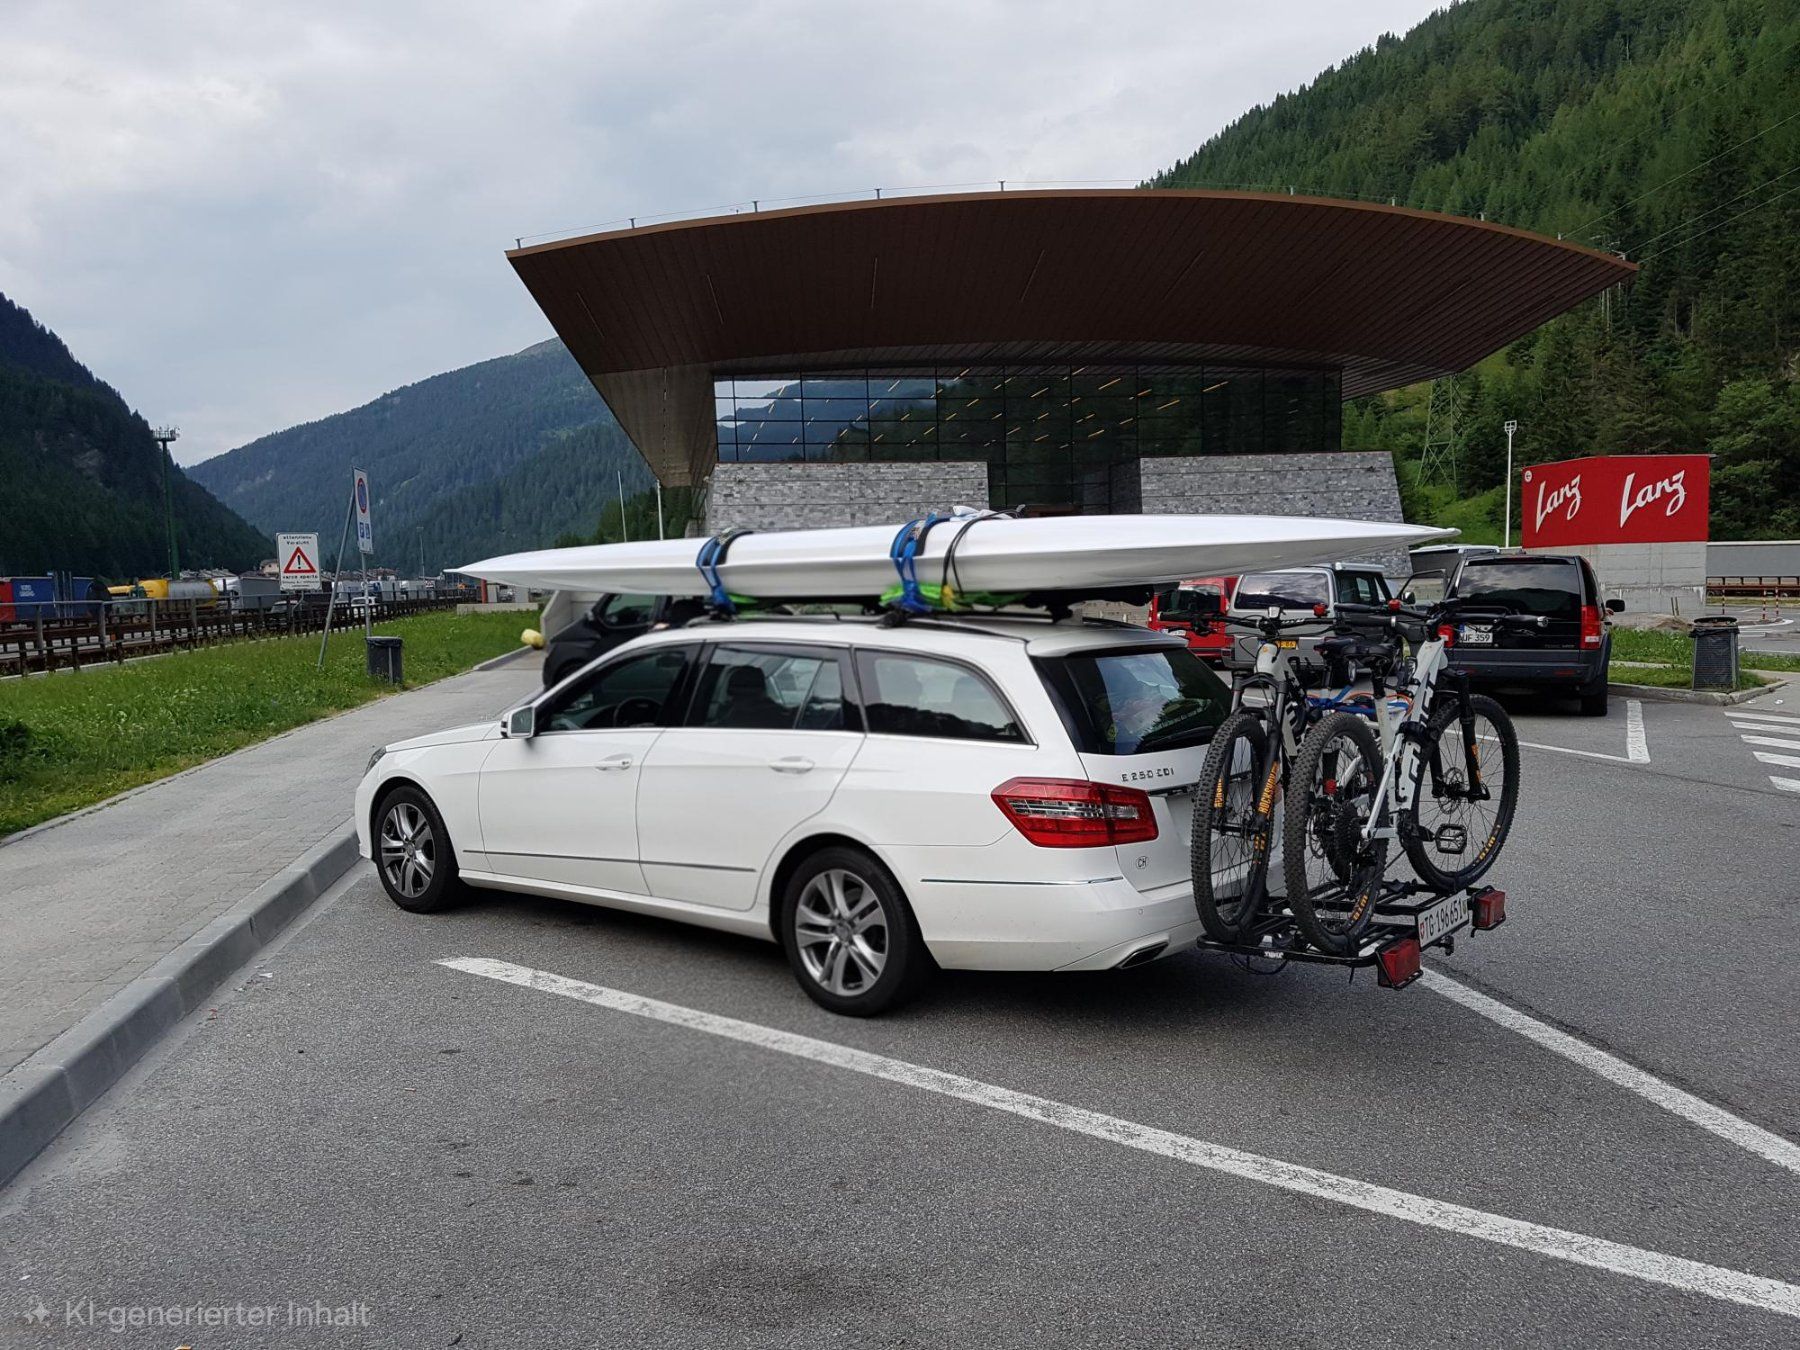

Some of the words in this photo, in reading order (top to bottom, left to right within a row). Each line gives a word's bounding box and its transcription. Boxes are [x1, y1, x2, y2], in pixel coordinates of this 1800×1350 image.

[1536, 474, 1582, 533] Lanz
[1620, 470, 1687, 528] Lanz
[1121, 773, 1129, 782] E
[1131, 770, 1154, 781] 250
[1156, 767, 1175, 777] CDI
